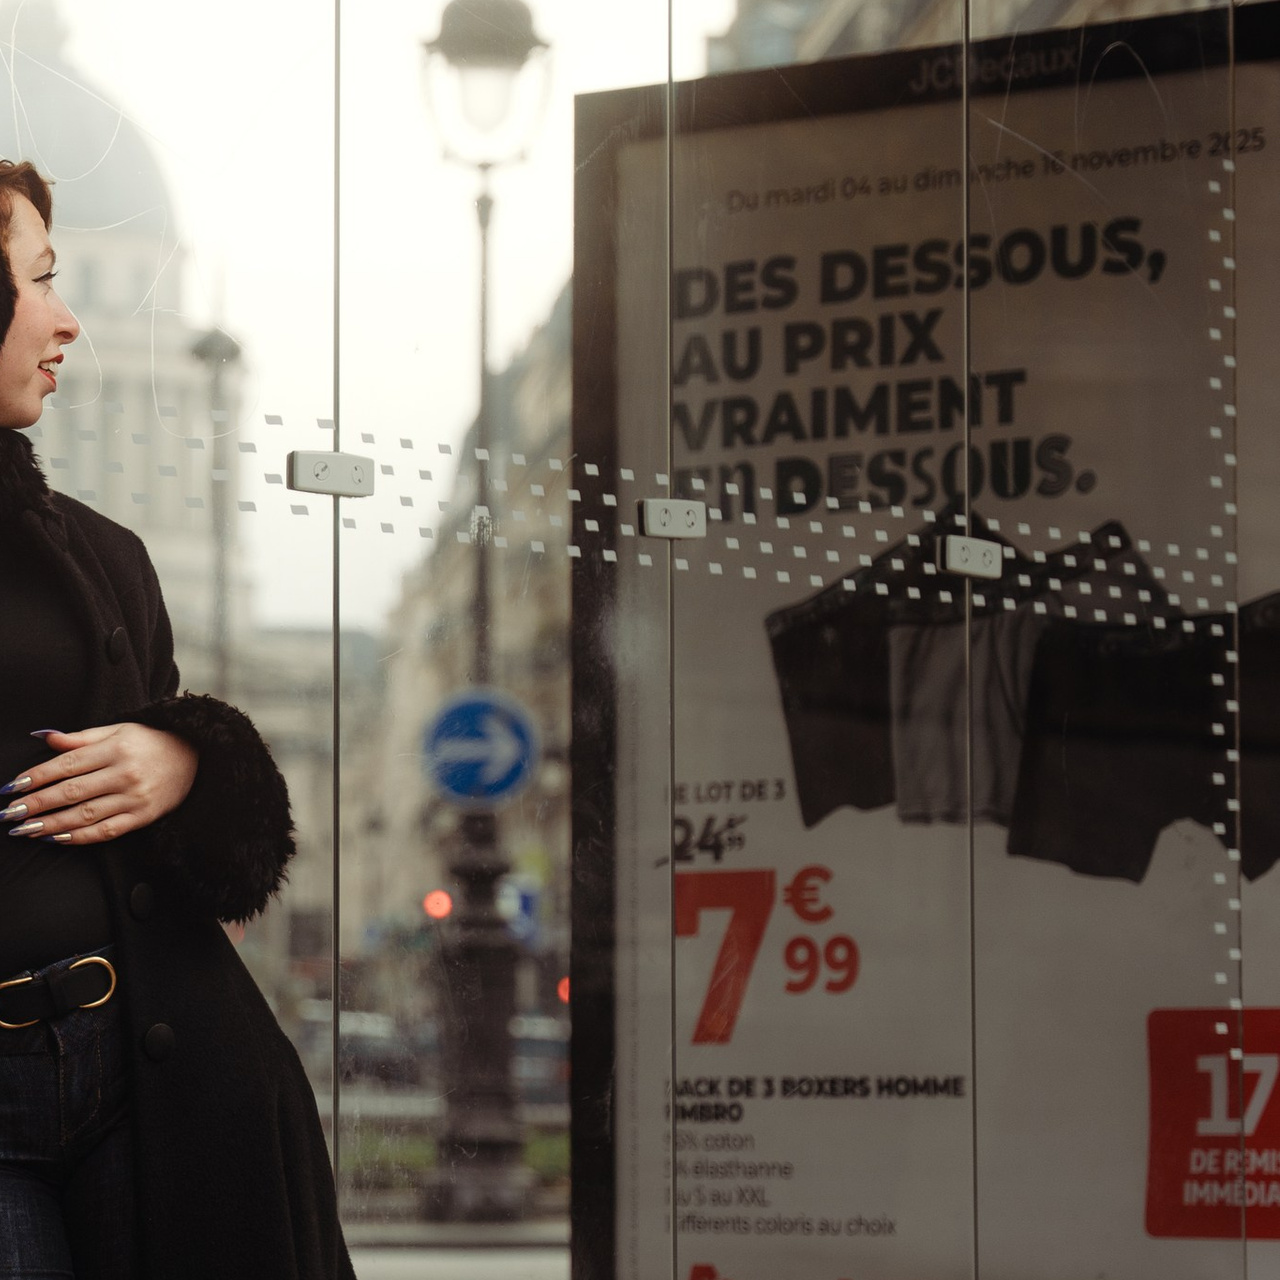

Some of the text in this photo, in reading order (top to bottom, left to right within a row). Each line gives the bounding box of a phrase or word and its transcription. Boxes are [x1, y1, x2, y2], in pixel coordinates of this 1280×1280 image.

[911, 47, 1076, 94] JCDecaux
[726, 189, 760, 213] Du
[766, 179, 836, 207] mardi
[878, 173, 908, 195] au
[913, 157, 1035, 192] dimnche
[1073, 137, 1203, 170] novembre
[674, 217, 1167, 319] DES DESSOUS,
[674, 308, 946, 386] AU PRIX
[673, 368, 1027, 453] VRAIMENT
[694, 780, 734, 804] LOT
[740, 778, 769, 802] DE
[773, 777, 787, 802] 3
[784, 934, 861, 996] 99
[666, 1074, 966, 1099] ACK DE 3 BOXERS HOMME
[1195, 1053, 1280, 1137] 17
[1189, 1148, 1221, 1175] DE
